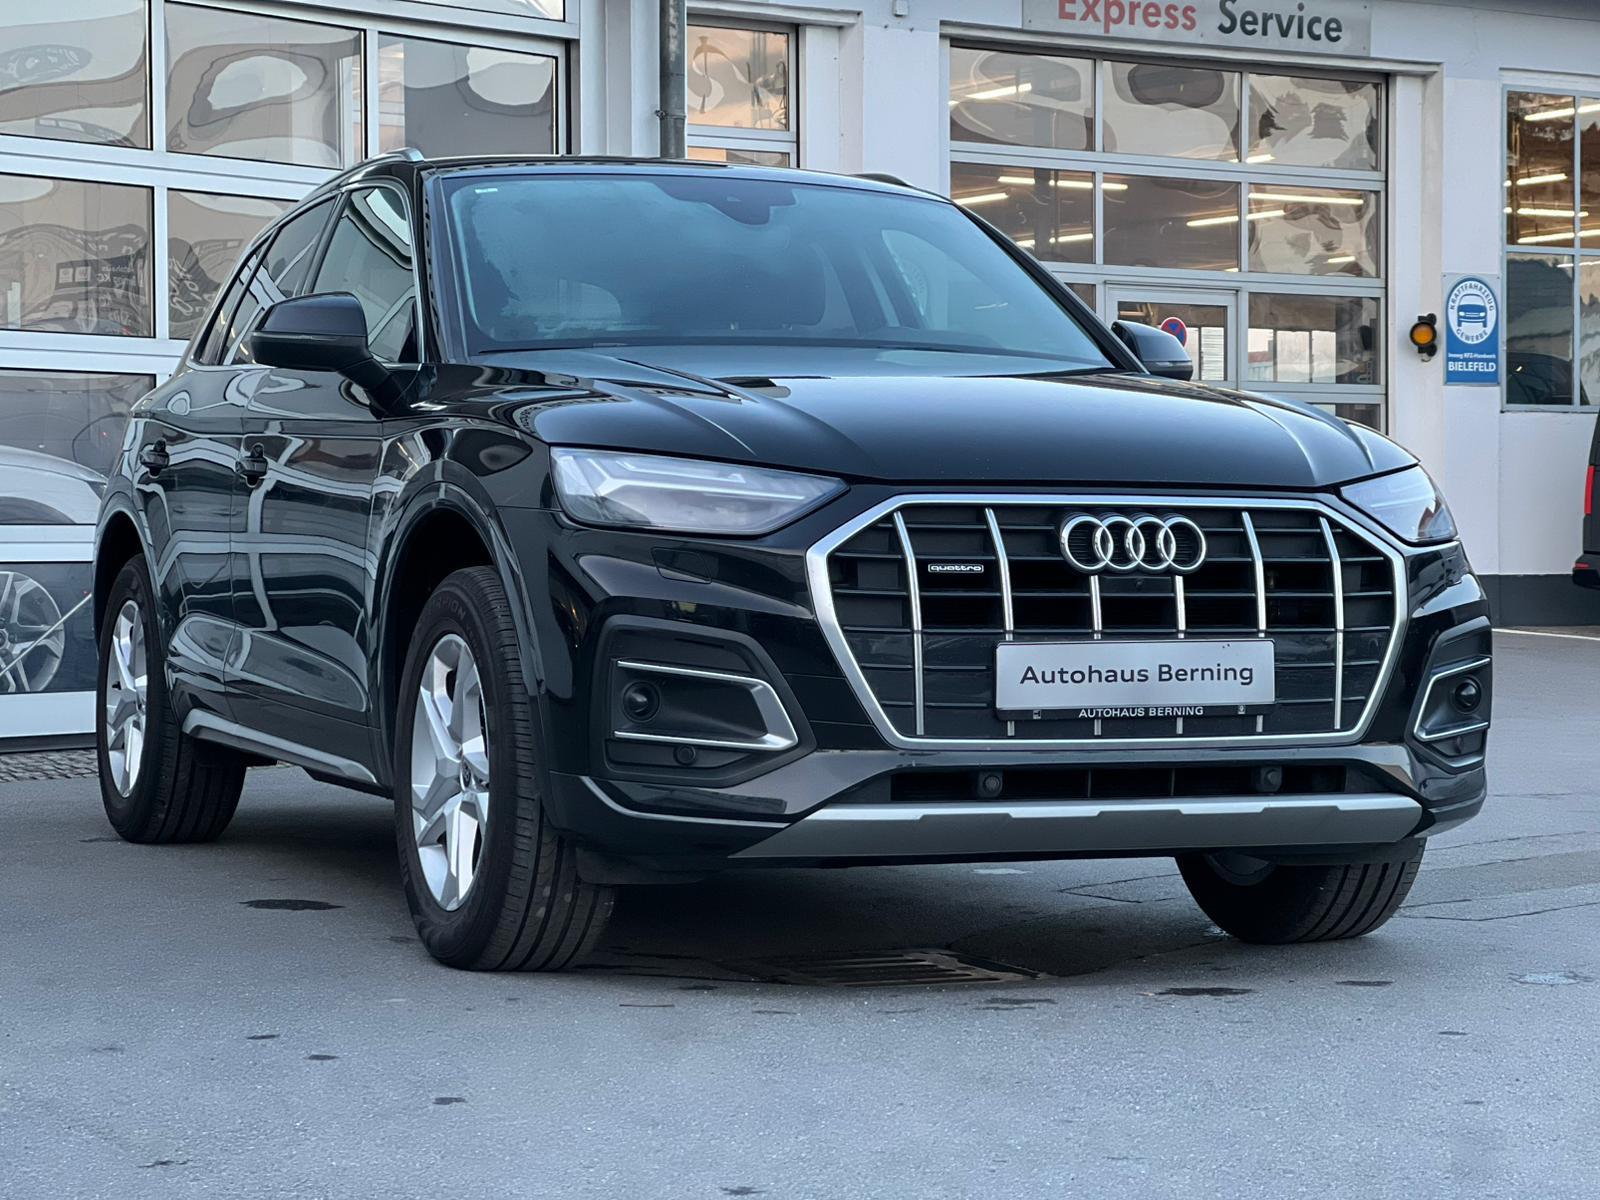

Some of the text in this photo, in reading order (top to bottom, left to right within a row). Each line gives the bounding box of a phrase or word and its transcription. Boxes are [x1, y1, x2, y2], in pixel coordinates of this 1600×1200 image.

[1057, 0, 1342, 42] Express Service
[1450, 283, 1495, 311] KRAFTFAHRZEUG
[1448, 361, 1496, 371] BIELEFELD
[930, 565, 982, 573] quattro
[1020, 663, 1253, 685] Autohaus Berning
[1078, 706, 1204, 718] AUTOHAUS BERNING
